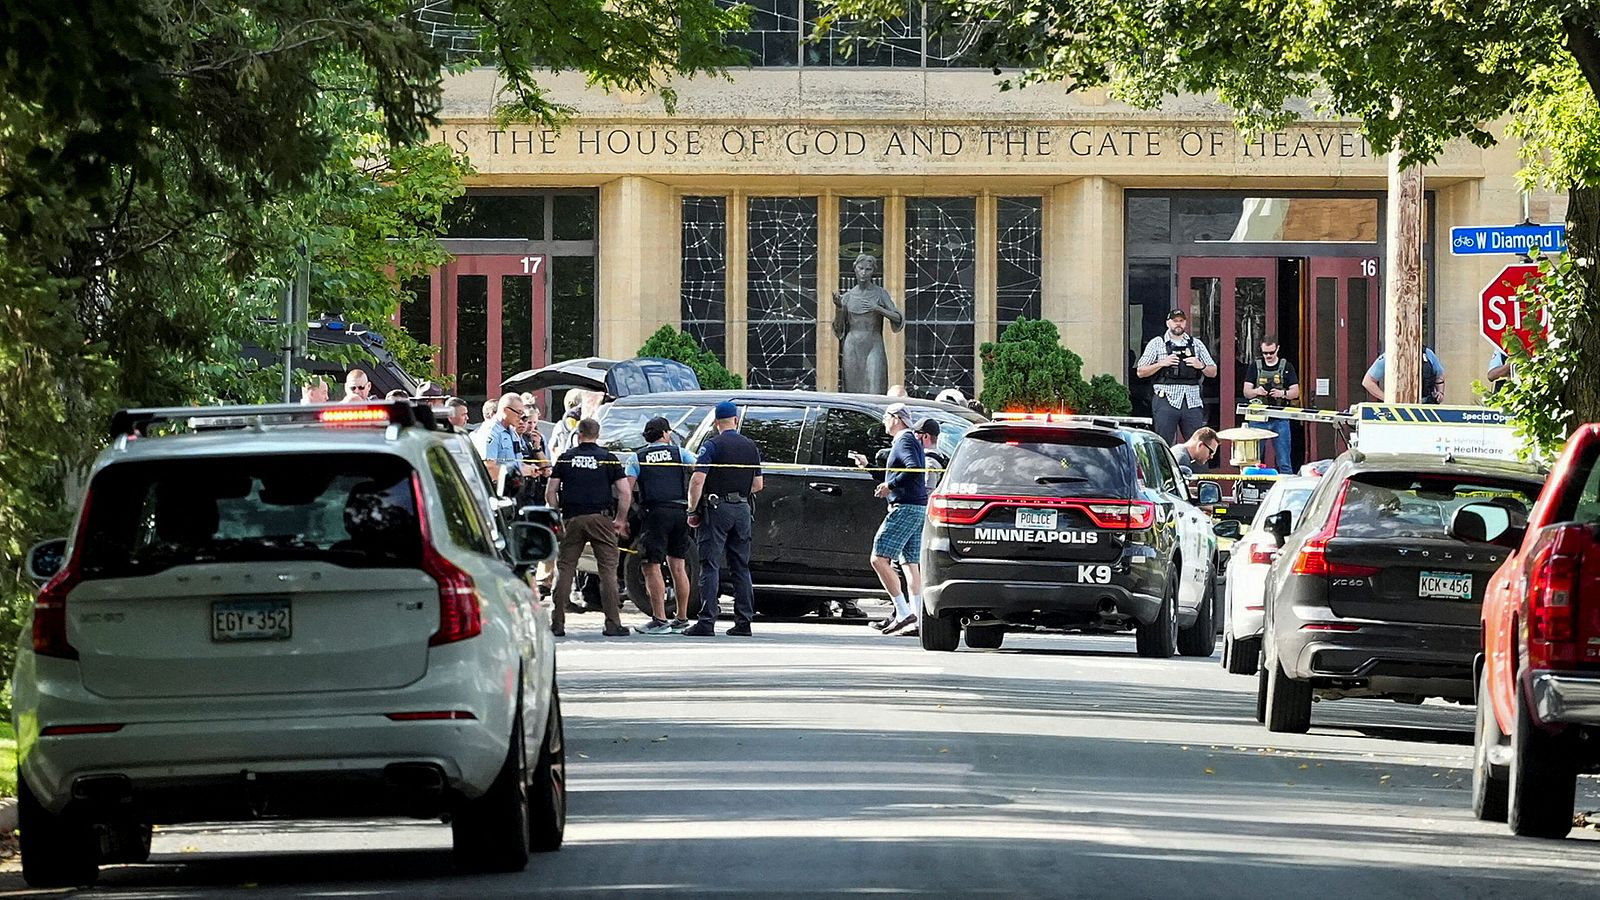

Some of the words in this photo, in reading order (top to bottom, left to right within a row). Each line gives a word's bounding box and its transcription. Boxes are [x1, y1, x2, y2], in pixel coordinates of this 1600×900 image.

[487, 130, 557, 154] THE
[577, 129, 701, 155] HOUSE
[721, 130, 766, 155] OF
[785, 129, 867, 155] GOD
[884, 130, 963, 156] AND
[981, 131, 1051, 156] THE
[1069, 131, 1161, 157] GATE
[1180, 131, 1225, 157] OF
[1475, 231, 1487, 250] W
[1491, 230, 1552, 249] Diamond
[520, 256, 542, 274] 17
[1360, 259, 1376, 277] 16
[1462, 412, 1492, 422] Special
[646, 453, 673, 463] POLICE
[1453, 446, 1504, 455] Healthcare
[571, 459, 598, 470] POLICE
[1020, 513, 1052, 525] POLICE
[974, 528, 1098, 544] MINNEAPOLIS
[1077, 565, 1112, 584] K9
[1332, 578, 1364, 587] XC60
[1421, 577, 1441, 592] KCK
[1449, 580, 1469, 594] 456
